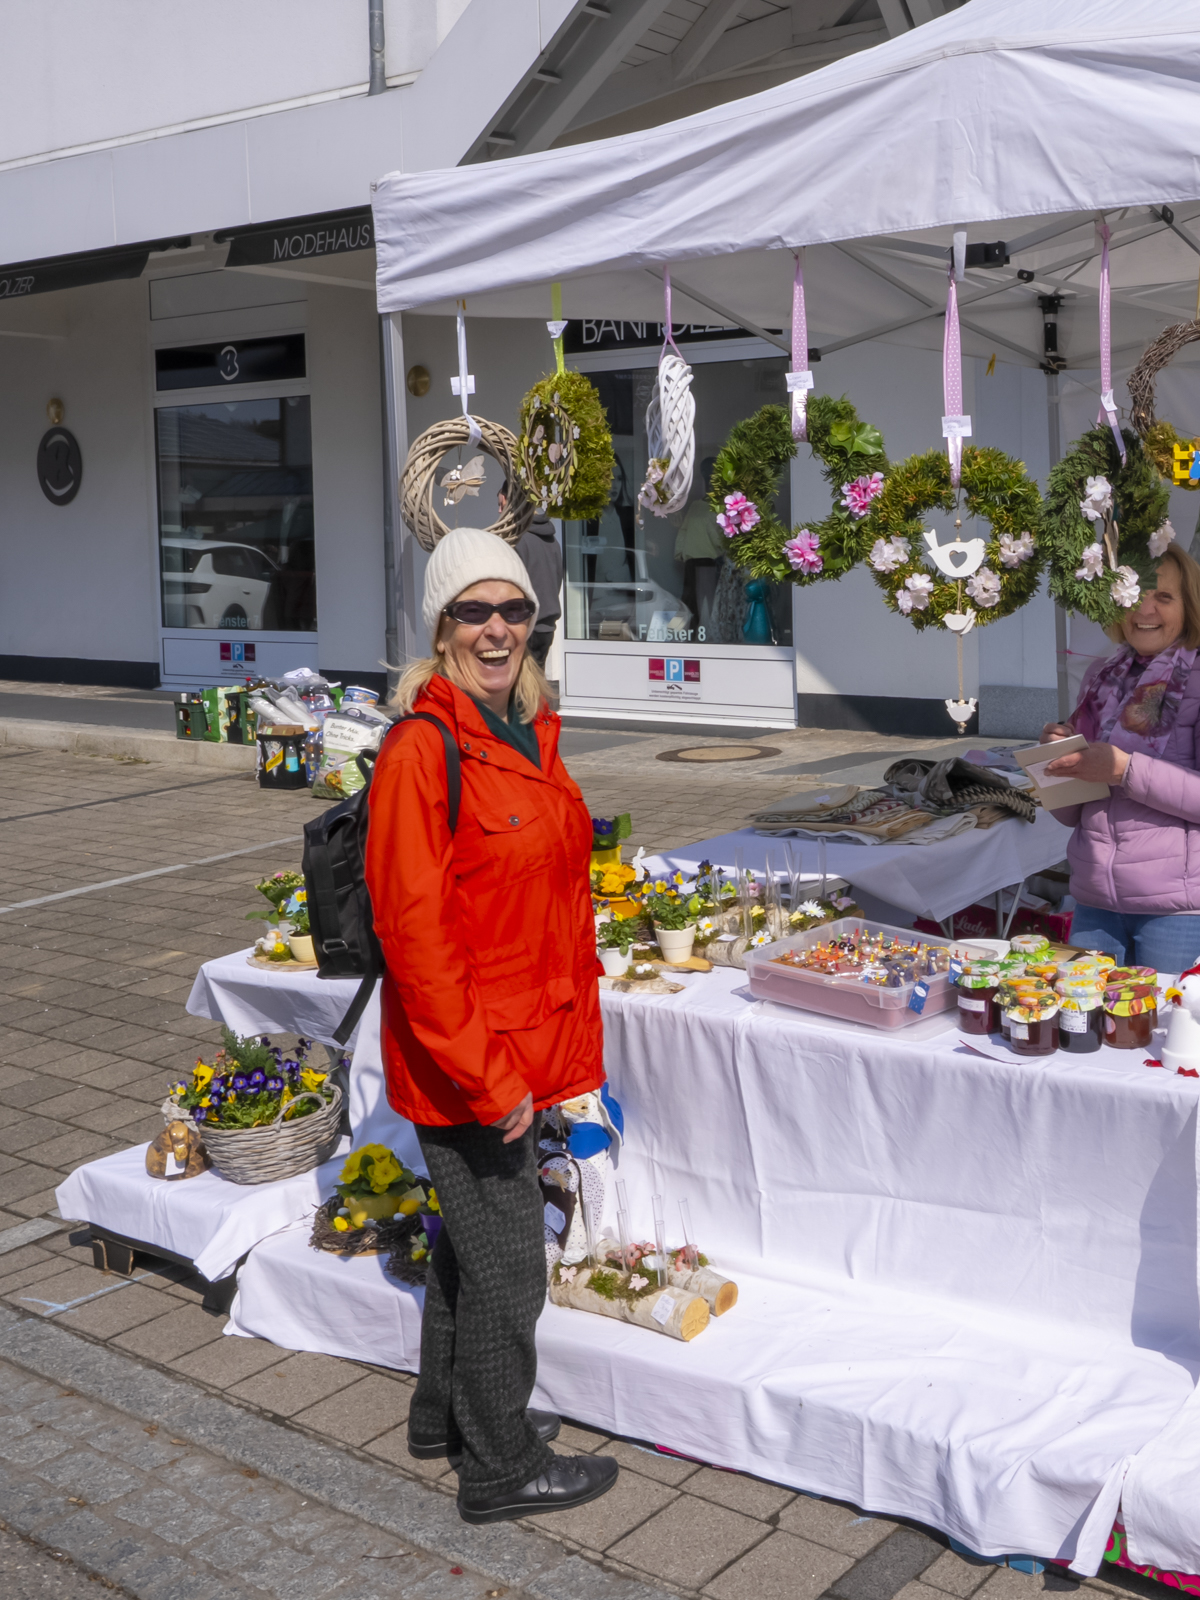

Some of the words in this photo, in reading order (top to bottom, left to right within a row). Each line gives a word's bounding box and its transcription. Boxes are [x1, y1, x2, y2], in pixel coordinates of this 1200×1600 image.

[273, 224, 371, 260] MODEHAUS
[639, 624, 694, 641] Fenster
[697, 626, 706, 642] 8
[234, 644, 242, 660] P
[669, 660, 680, 680] P
[954, 915, 988, 938] Lady
